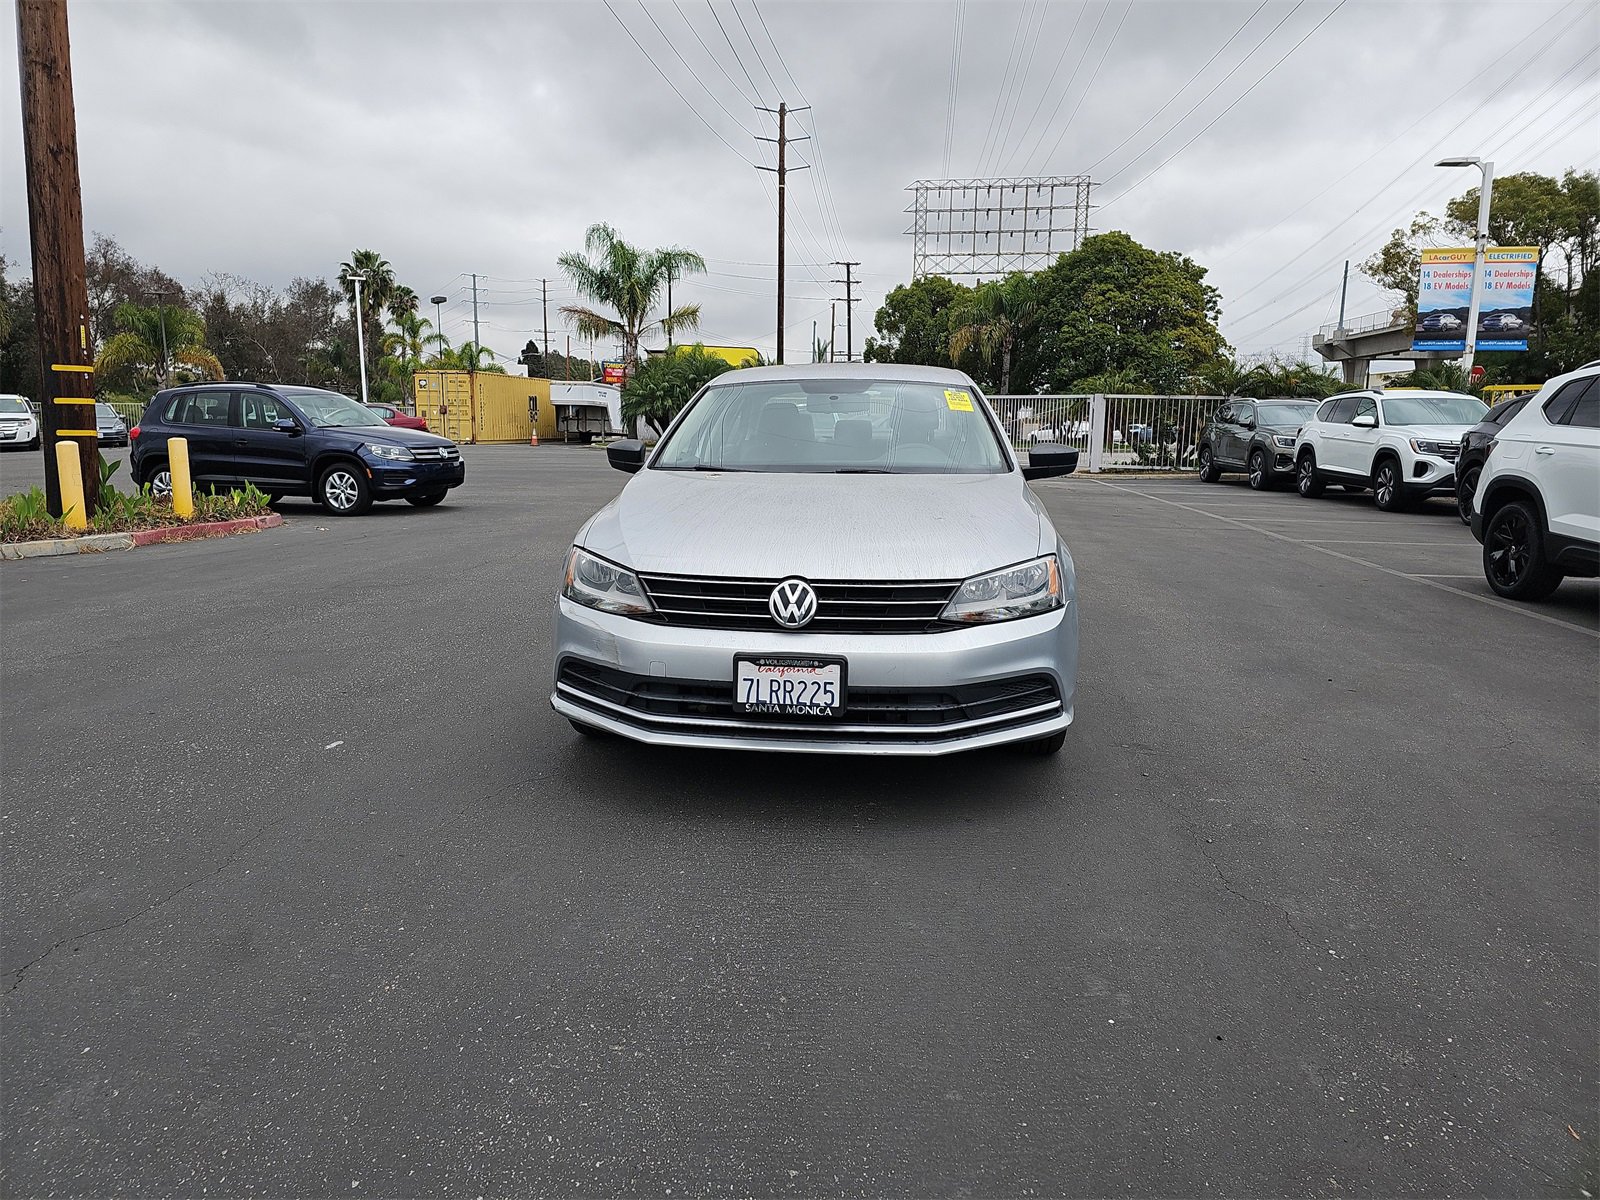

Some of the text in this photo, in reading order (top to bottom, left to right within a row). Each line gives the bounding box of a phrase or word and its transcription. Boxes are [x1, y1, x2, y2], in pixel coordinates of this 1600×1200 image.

[1428, 253, 1468, 261] LAcarGUY
[1488, 252, 1533, 260] ELECTRIFIED
[1423, 270, 1472, 280] 14 Dealerships
[1484, 269, 1534, 280] 14 Dealerships
[1423, 282, 1469, 290] 18 EV Models
[1484, 281, 1531, 290] 18 EV Models
[757, 665, 823, 678] California
[742, 678, 835, 707] 7LRR225
[745, 703, 833, 716] SANTA MONICA
